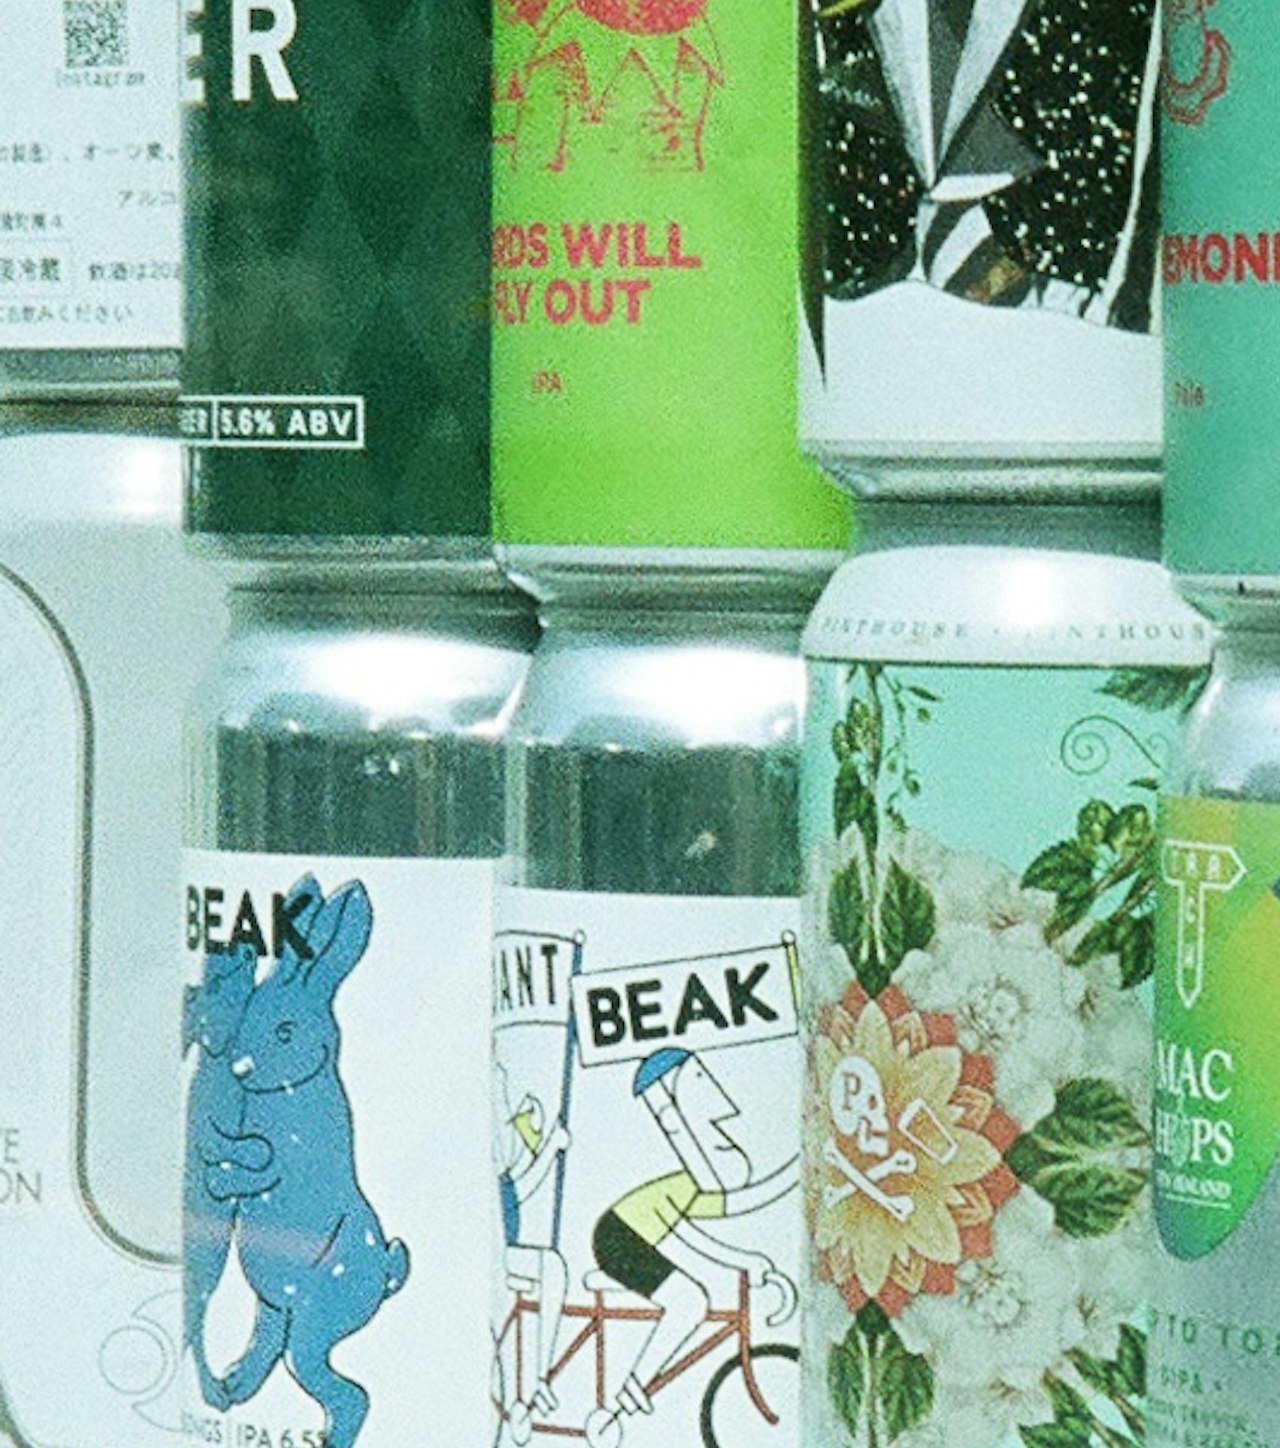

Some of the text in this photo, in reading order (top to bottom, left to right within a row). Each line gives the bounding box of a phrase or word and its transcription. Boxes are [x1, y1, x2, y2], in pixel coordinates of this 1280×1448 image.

[561, 219, 702, 269] WILL
[543, 277, 652, 327] OUT
[220, 408, 276, 436] 5.6%
[287, 409, 353, 437] ABV
[185, 884, 316, 961] BEAK
[586, 961, 780, 1048] BEAK
[841, 1071, 862, 1112] P
